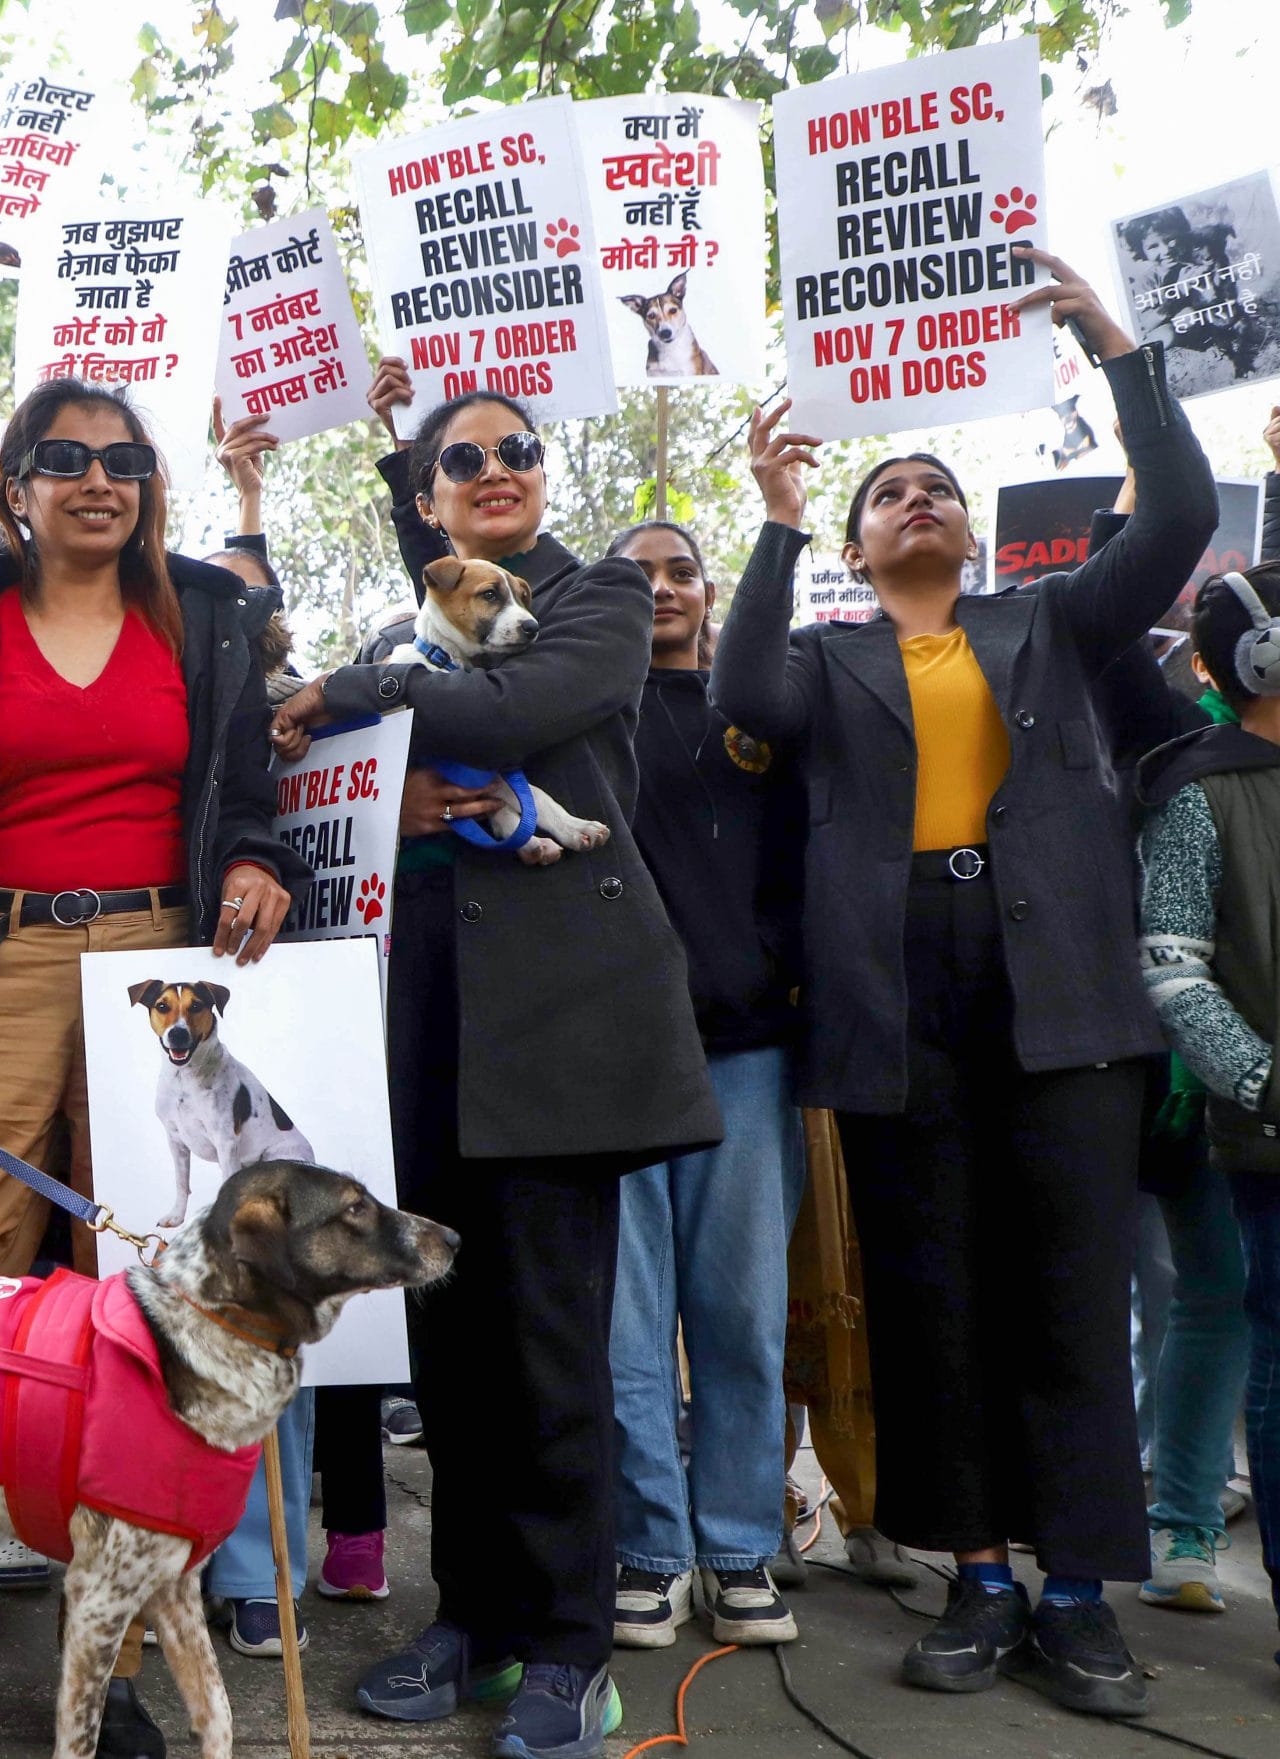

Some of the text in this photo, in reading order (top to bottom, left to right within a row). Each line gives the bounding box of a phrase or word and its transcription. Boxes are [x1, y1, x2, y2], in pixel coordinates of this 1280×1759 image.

[24, 77, 95, 111] शेल्टर
[17, 109, 72, 134] नहीं
[623, 107, 704, 141] क्या मैं
[808, 83, 1004, 155] HON'BLE SC,
[1, 161, 50, 191] जेल
[388, 133, 545, 196] HON'BLE SC,
[602, 142, 720, 191] स्वदेशी
[836, 140, 980, 206] RECALL
[415, 178, 532, 234] RECALL
[624, 186, 702, 230] नहीं हूँ
[837, 192, 983, 260] REVIEW
[62, 218, 183, 250] जब मुझपर
[272, 229, 322, 273] कोर्ट
[421, 222, 537, 277] REVIEW
[600, 236, 660, 270] मोदी
[664, 234, 698, 267] जी
[58, 246, 180, 281] तेज़ाब फेका
[796, 239, 1035, 320] RECONSIDER
[1133, 252, 1263, 312] आवारा नहीं
[75, 279, 154, 308] जाता है
[228, 289, 321, 340] 7 नवंबर
[391, 264, 583, 329] RECONSIDER
[1170, 288, 1258, 335] हमारा है
[54, 313, 167, 346] कोर्ट को वो
[231, 323, 339, 378] का आदेश
[411, 319, 576, 370] NOV 7 ORDER
[814, 324, 873, 367] NOV
[885, 319, 904, 356] 7
[917, 304, 1021, 350] ORDER
[81, 352, 159, 383] दिखता
[443, 363, 553, 400] ON DOGS
[850, 351, 986, 403] ON DOGS
[242, 381, 308, 416] वापस
[278, 757, 380, 816] ON'BLE SC,
